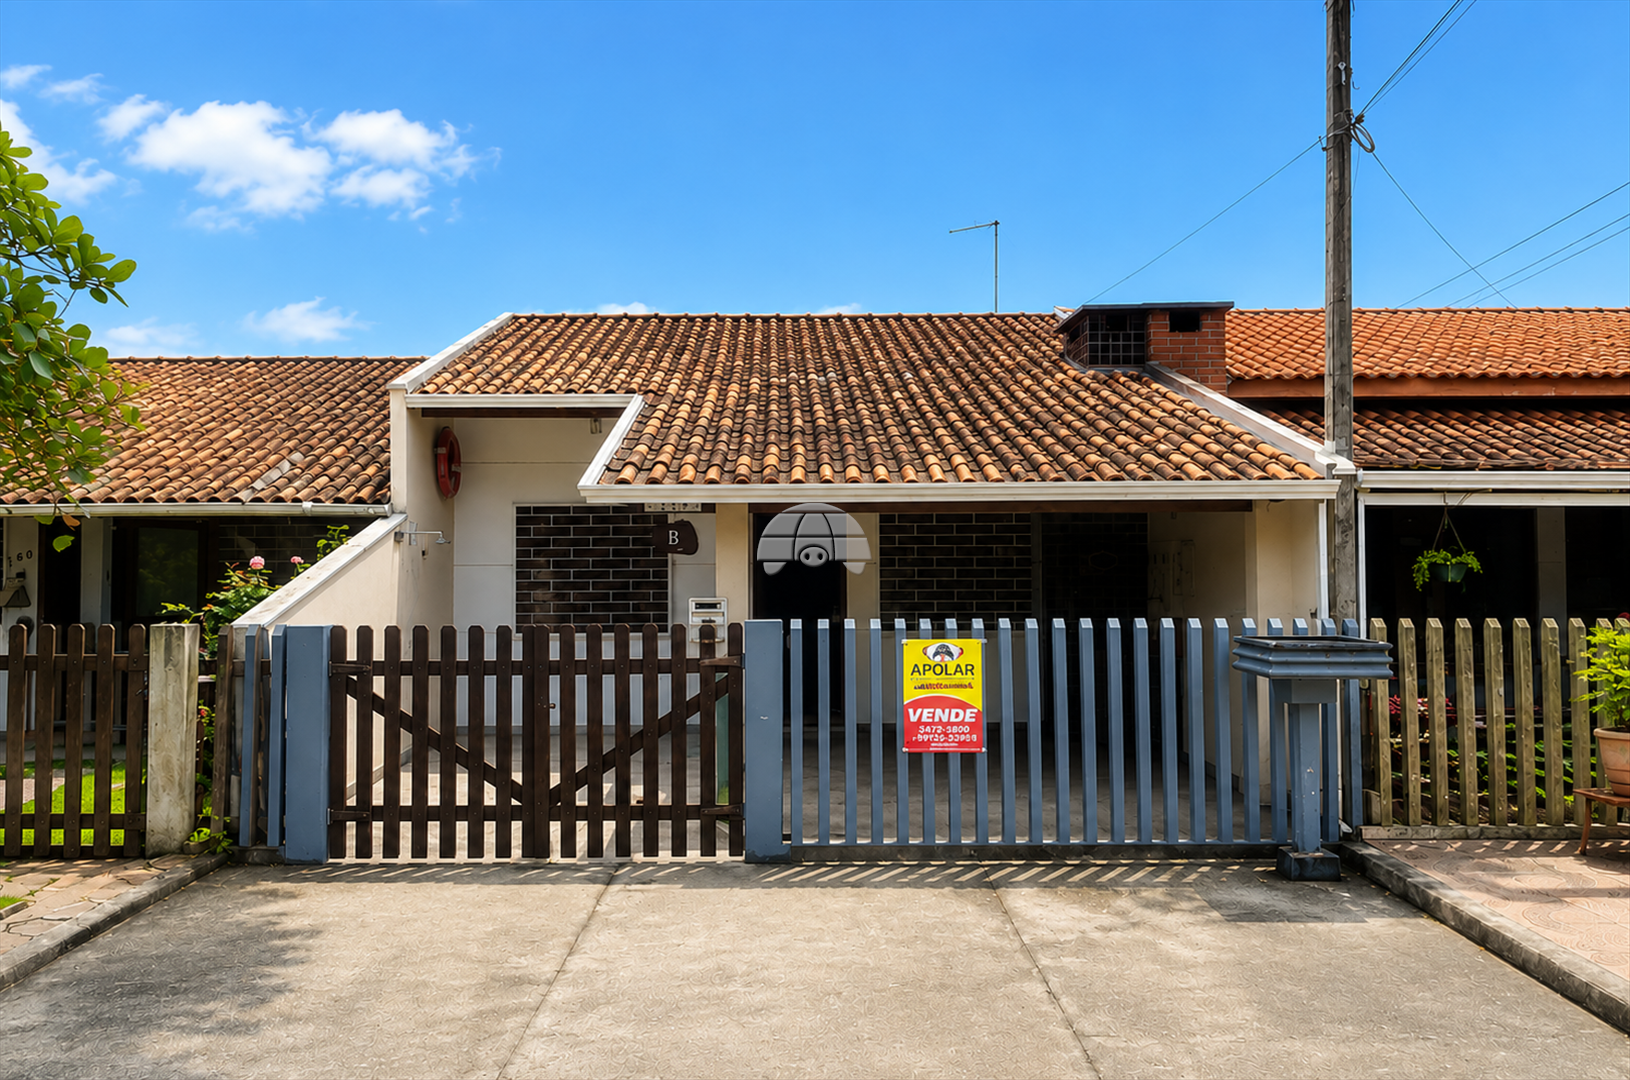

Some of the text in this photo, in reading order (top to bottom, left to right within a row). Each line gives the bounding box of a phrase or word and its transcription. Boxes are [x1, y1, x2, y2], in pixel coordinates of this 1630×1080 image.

[668, 530, 679, 545] B
[910, 663, 975, 676] APOLAR
[908, 708, 979, 723] VENDE
